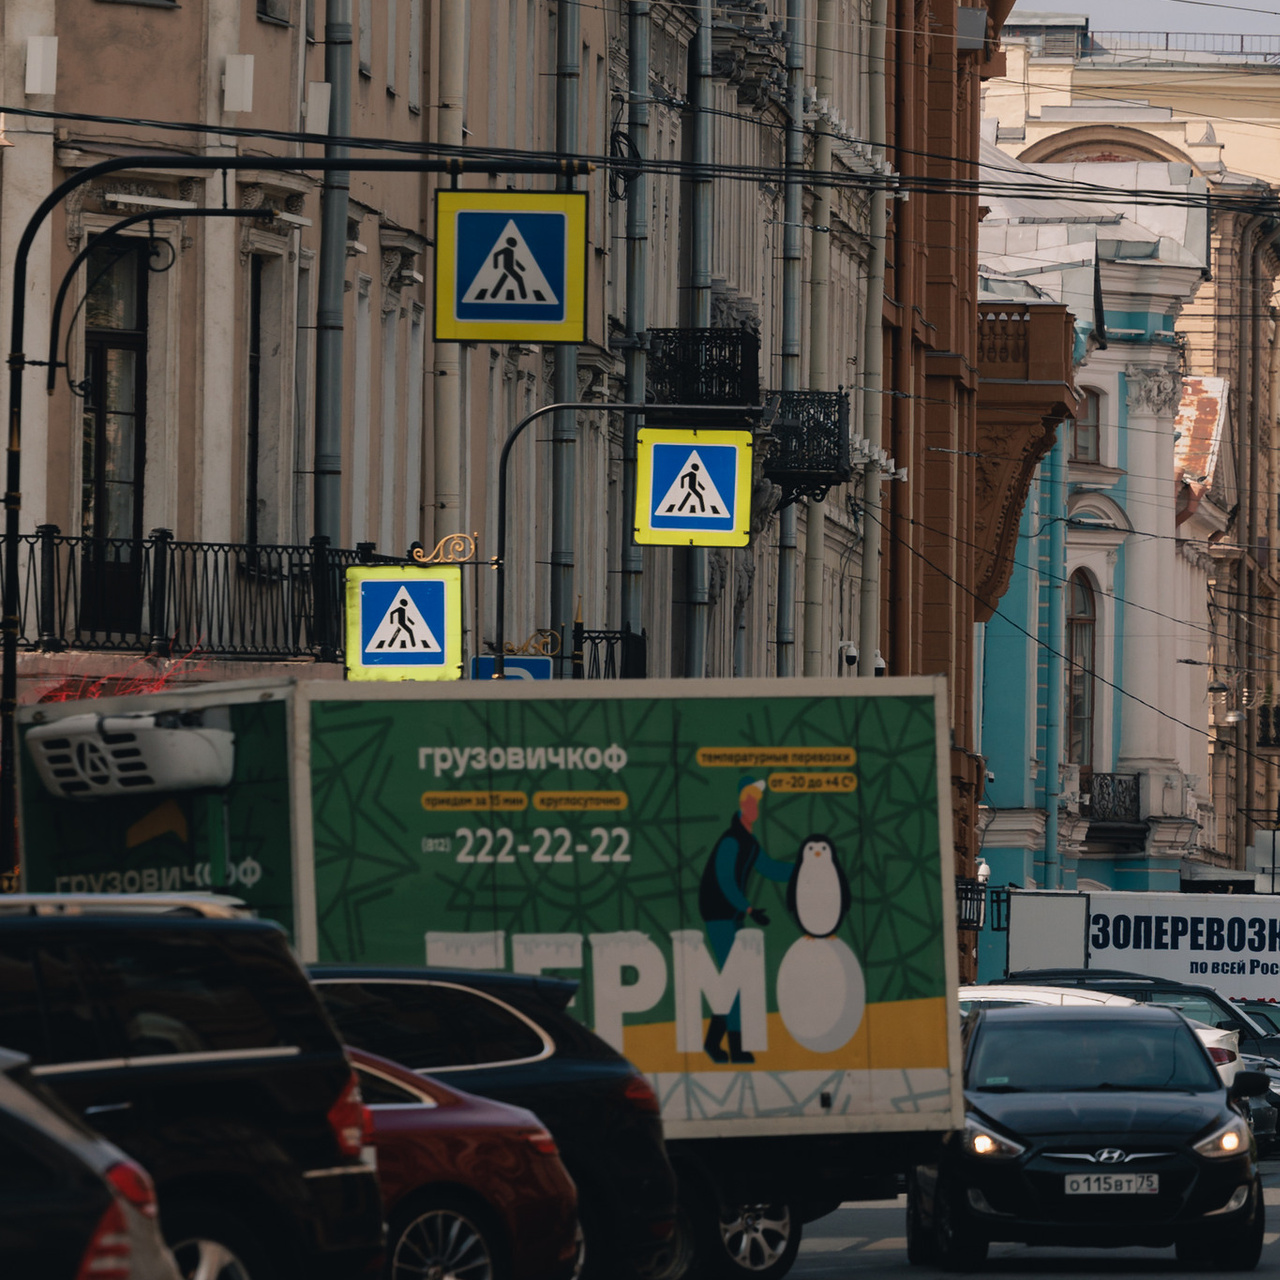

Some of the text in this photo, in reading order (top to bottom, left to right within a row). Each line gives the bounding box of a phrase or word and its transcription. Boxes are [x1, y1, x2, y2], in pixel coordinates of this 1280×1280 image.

[418, 743, 628, 778] грузовичкоф
[791, 753, 851, 764] перевозки
[455, 827, 632, 863] 222-22-22
